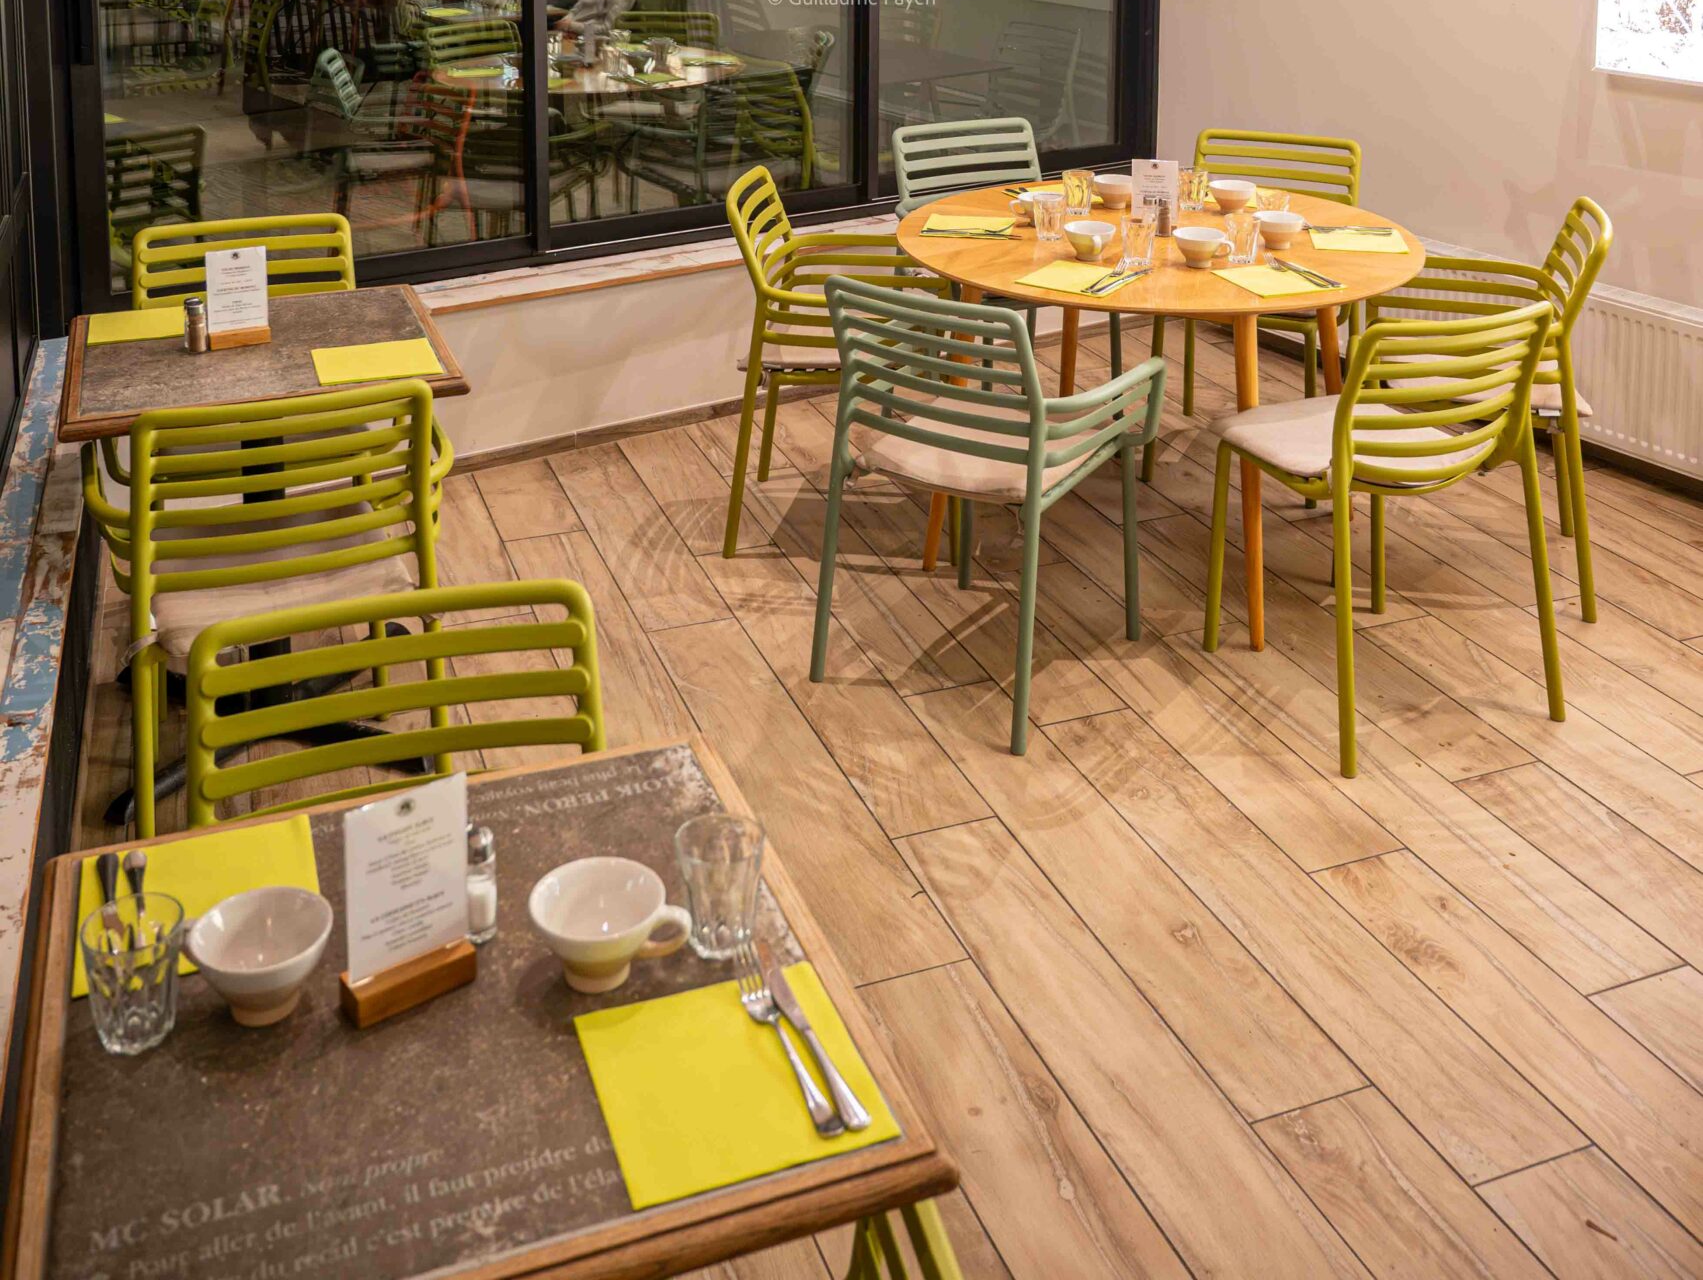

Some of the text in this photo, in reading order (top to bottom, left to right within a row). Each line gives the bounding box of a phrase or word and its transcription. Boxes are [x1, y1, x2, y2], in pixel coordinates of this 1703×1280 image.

[404, 1182, 420, 1204] il
[428, 1172, 476, 1199] faut
[88, 1217, 149, 1253] MC
